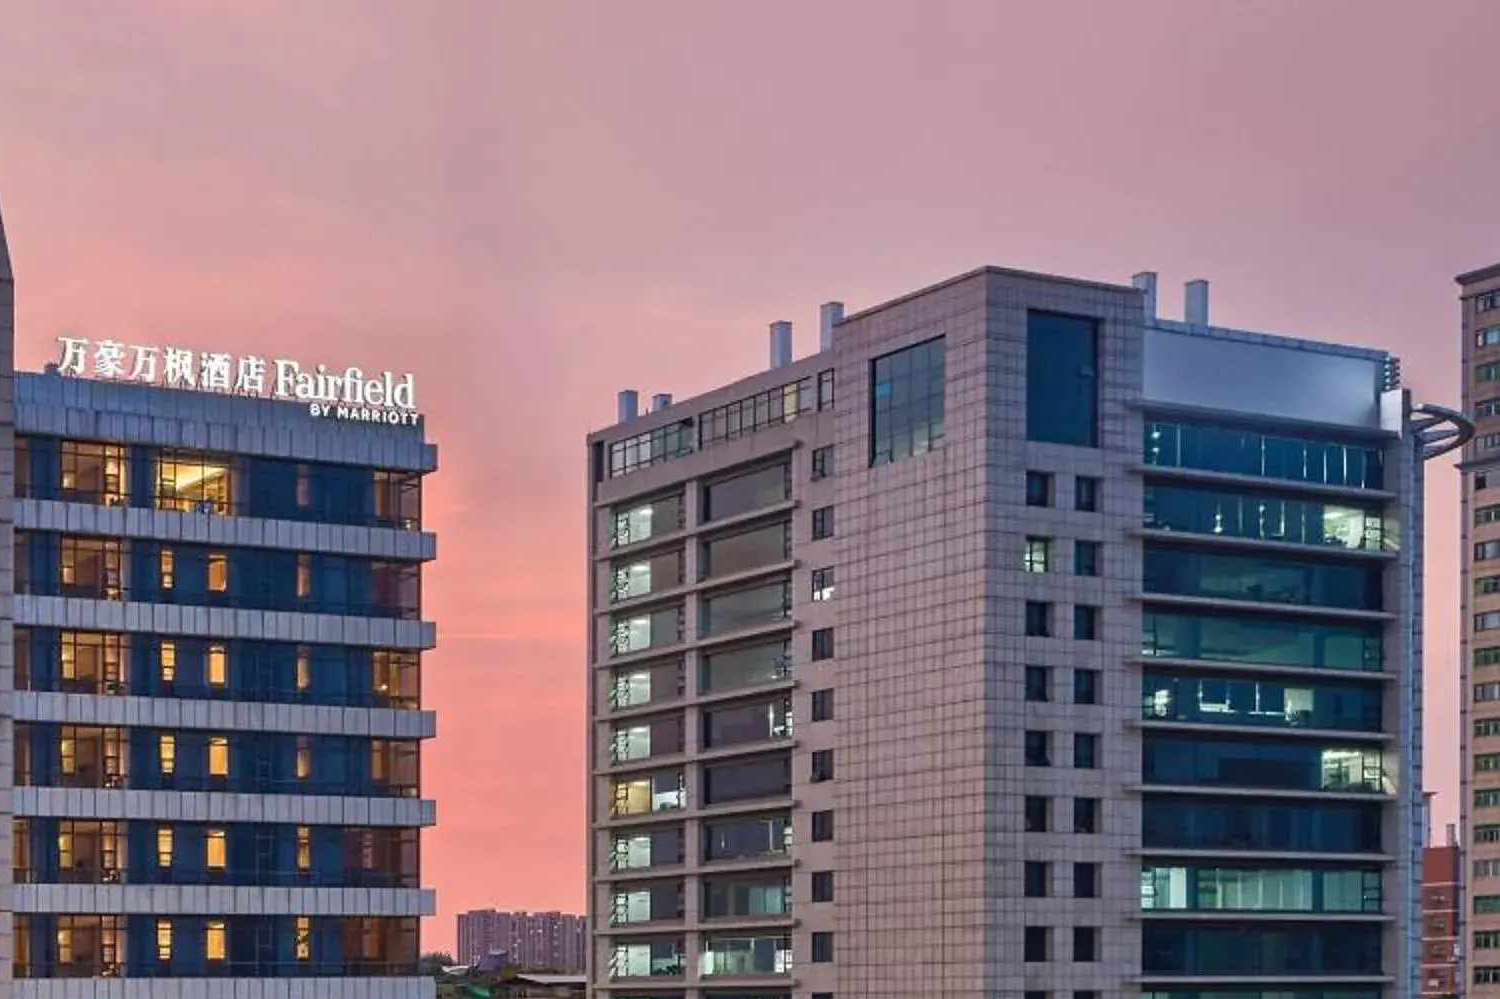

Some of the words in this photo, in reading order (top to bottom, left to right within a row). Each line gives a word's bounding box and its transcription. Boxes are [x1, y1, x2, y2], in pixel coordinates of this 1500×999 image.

[56, 336, 266, 394] 万豪万枫酒店
[274, 359, 416, 409] Fairfield
[310, 403, 331, 418] BY
[337, 405, 419, 426] MARRIOTT
